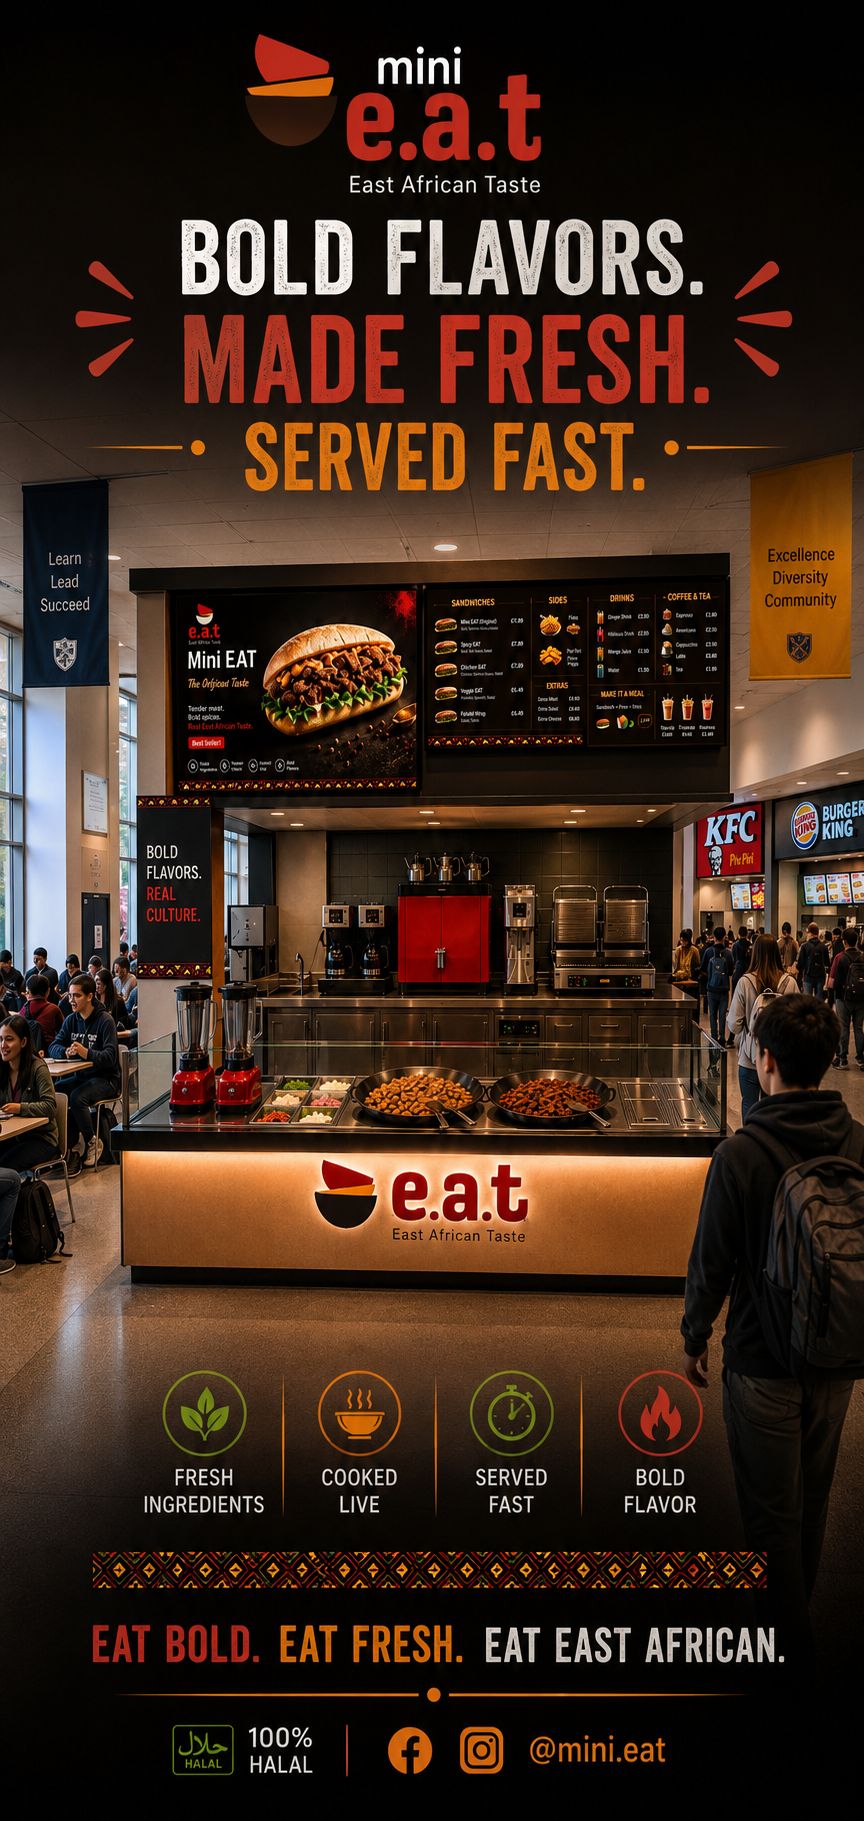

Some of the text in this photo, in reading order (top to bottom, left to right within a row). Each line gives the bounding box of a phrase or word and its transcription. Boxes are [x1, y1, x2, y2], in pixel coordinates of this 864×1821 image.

[49, 552, 82, 566] Learn
[768, 547, 835, 562] Excellence
[51, 574, 79, 589] Lead
[773, 569, 828, 587] Diversity
[40, 596, 90, 612] Succeed
[451, 598, 496, 607] SANDWICHES
[548, 596, 568, 605] SIDES
[667, 593, 692, 601] COFFEE
[699, 592, 712, 600] TEA
[764, 592, 837, 609] Community
[188, 624, 221, 639] e.a.t
[188, 650, 257, 669] Mini EAT
[822, 799, 864, 822] BURGER
[704, 810, 756, 847] KFC
[822, 819, 853, 840] KING
[147, 845, 177, 858] BOLD
[147, 866, 201, 879] FLAVORS.
[147, 887, 175, 900] REAL
[147, 908, 200, 922] CULTURE.
[391, 1164, 529, 1223] e.a.t
[392, 1227, 526, 1243] East African Taste
